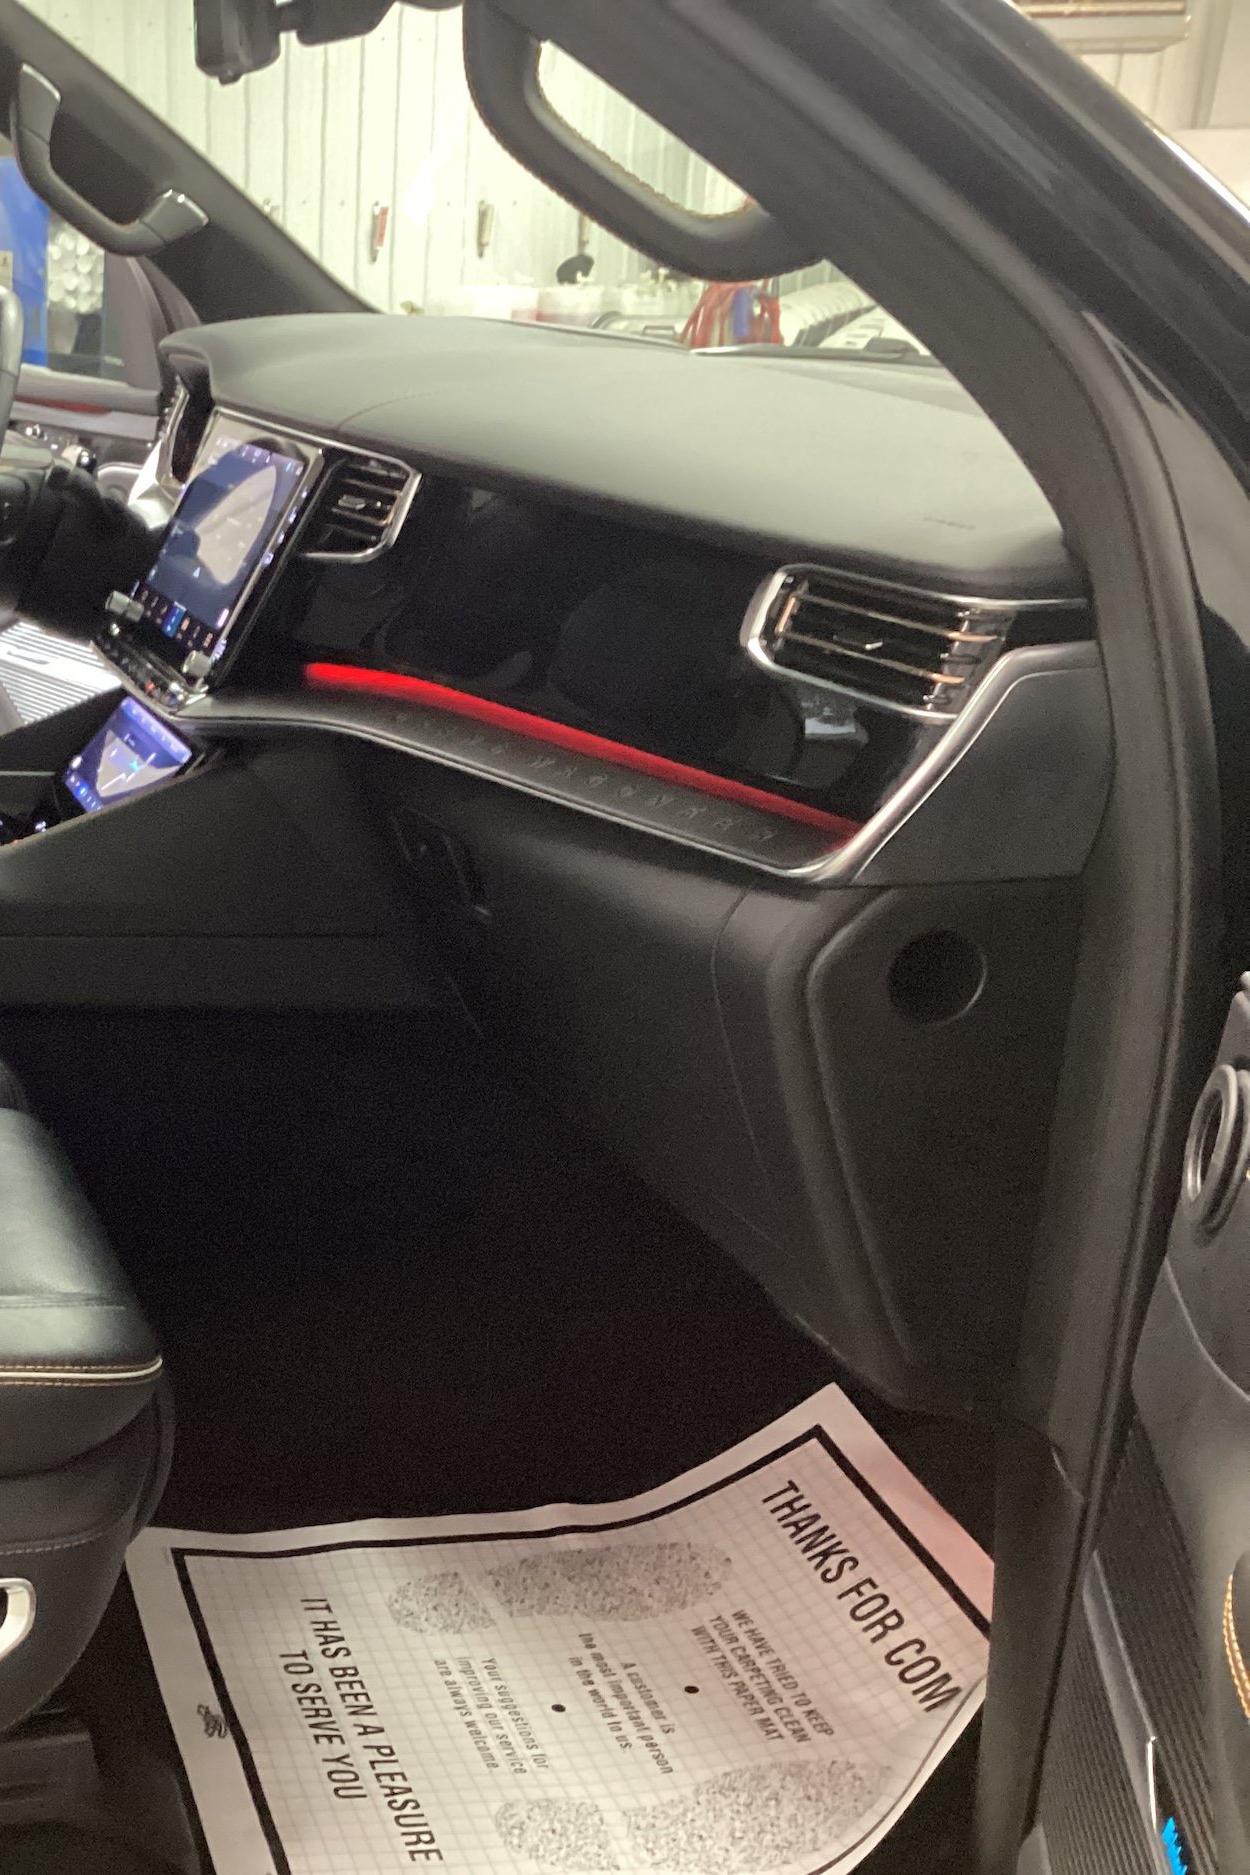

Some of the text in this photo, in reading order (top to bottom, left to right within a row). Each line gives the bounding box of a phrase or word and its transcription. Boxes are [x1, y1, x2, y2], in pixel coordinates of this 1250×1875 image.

[762, 1480, 963, 1713] THANKS FOR COM
[279, 1650, 368, 1799] TO SERVE YOU
[301, 1599, 444, 1862] IT HAS BEEN A PLEASURE
[434, 1660, 452, 1677] are
[444, 1680, 472, 1717] always
[456, 1657, 527, 1774] improving our service
[481, 1658, 549, 1768] Your suggestions for
[576, 1669, 595, 1686] the
[588, 1689, 618, 1719] world
[607, 1721, 622, 1732] to
[578, 1633, 674, 1774] the most important person
[620, 1662, 675, 1734] A customer is
[691, 1625, 785, 1740] WITH THIS PAPER MAT
[710, 1615, 811, 1743] YOUR CARPETING CLEAN
[732, 1609, 835, 1736] WE HAVE TRIED TO KEEP
